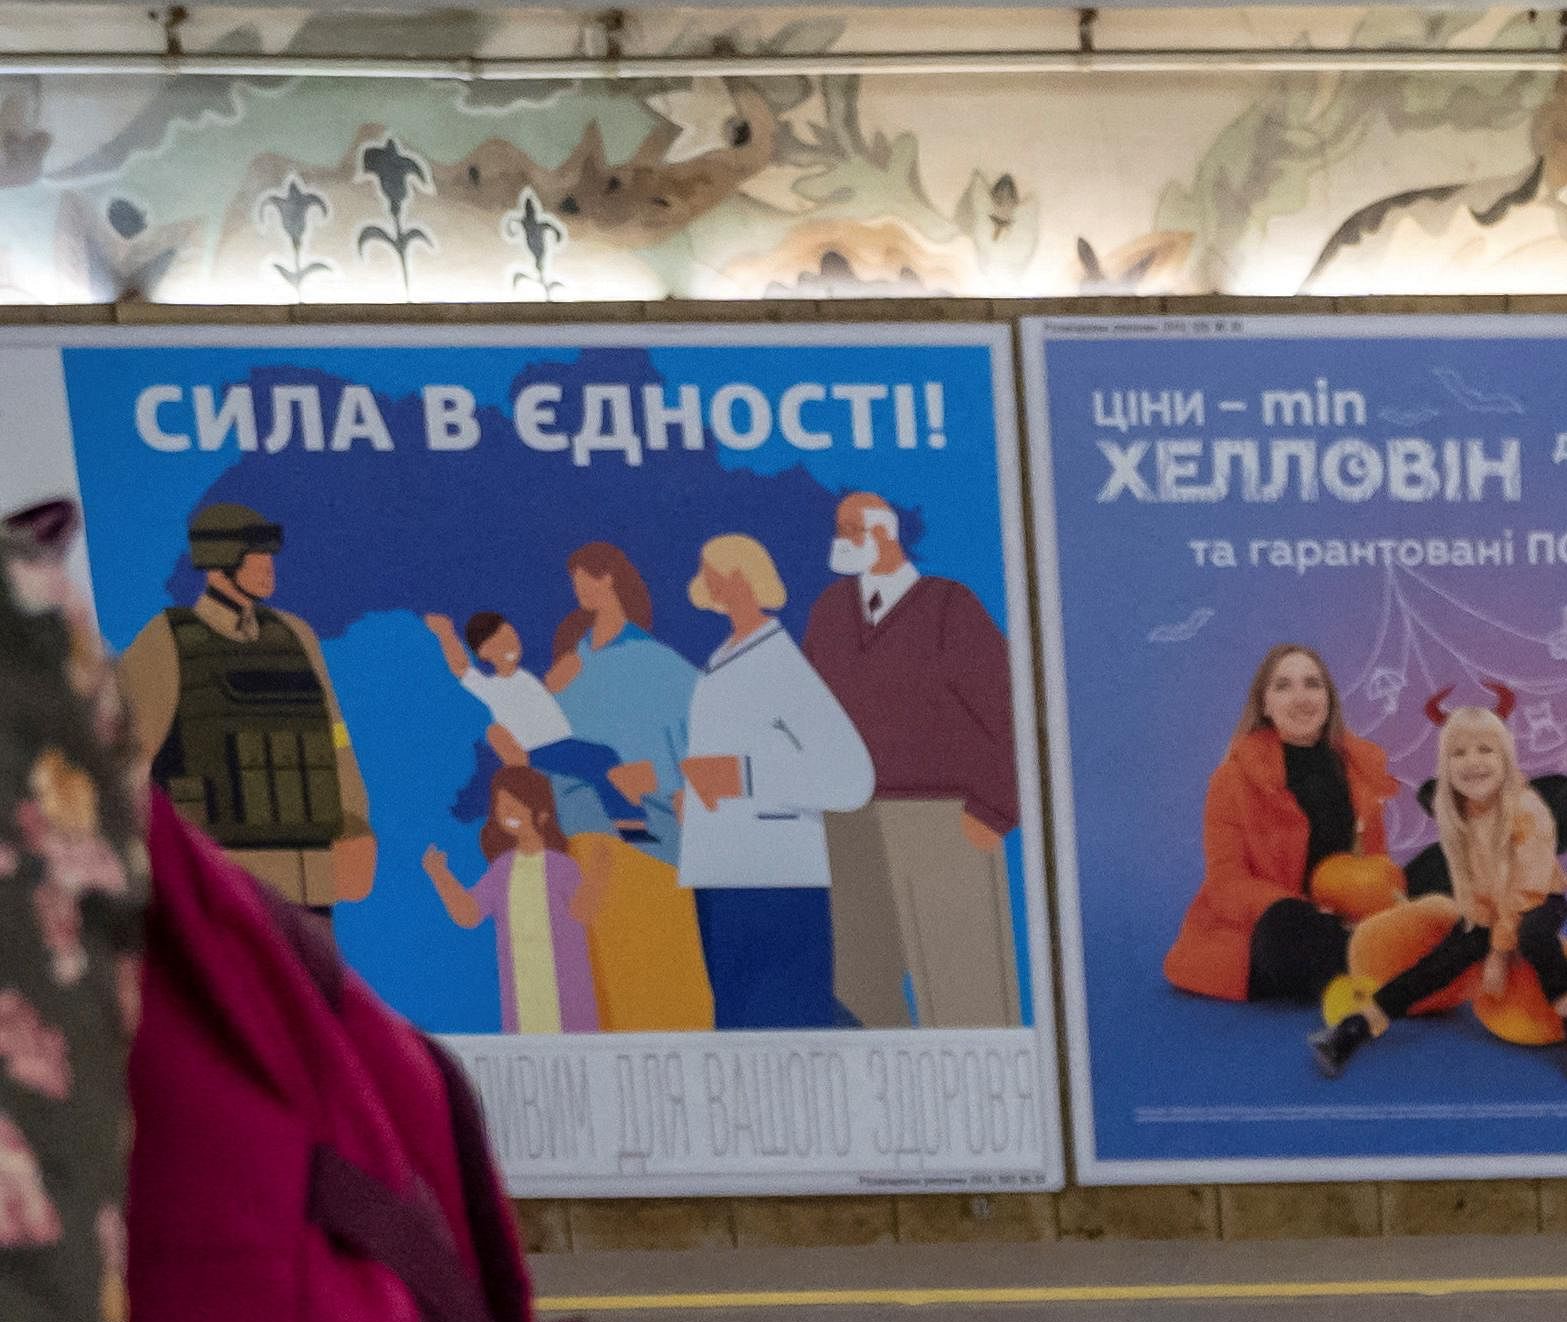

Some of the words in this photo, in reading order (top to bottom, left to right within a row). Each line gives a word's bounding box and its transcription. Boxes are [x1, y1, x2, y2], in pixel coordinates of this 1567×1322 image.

[135, 384, 395, 454] СИЛА
[422, 384, 481, 452] В
[513, 381, 947, 467] ЄДНОСТІ!
[1092, 391, 1205, 432] ЦІНИ
[1262, 377, 1367, 425] min
[1096, 438, 1523, 502] ХЕЛЛОВІН
[1189, 538, 1237, 567] та
[1249, 530, 1514, 575] гарантовані
